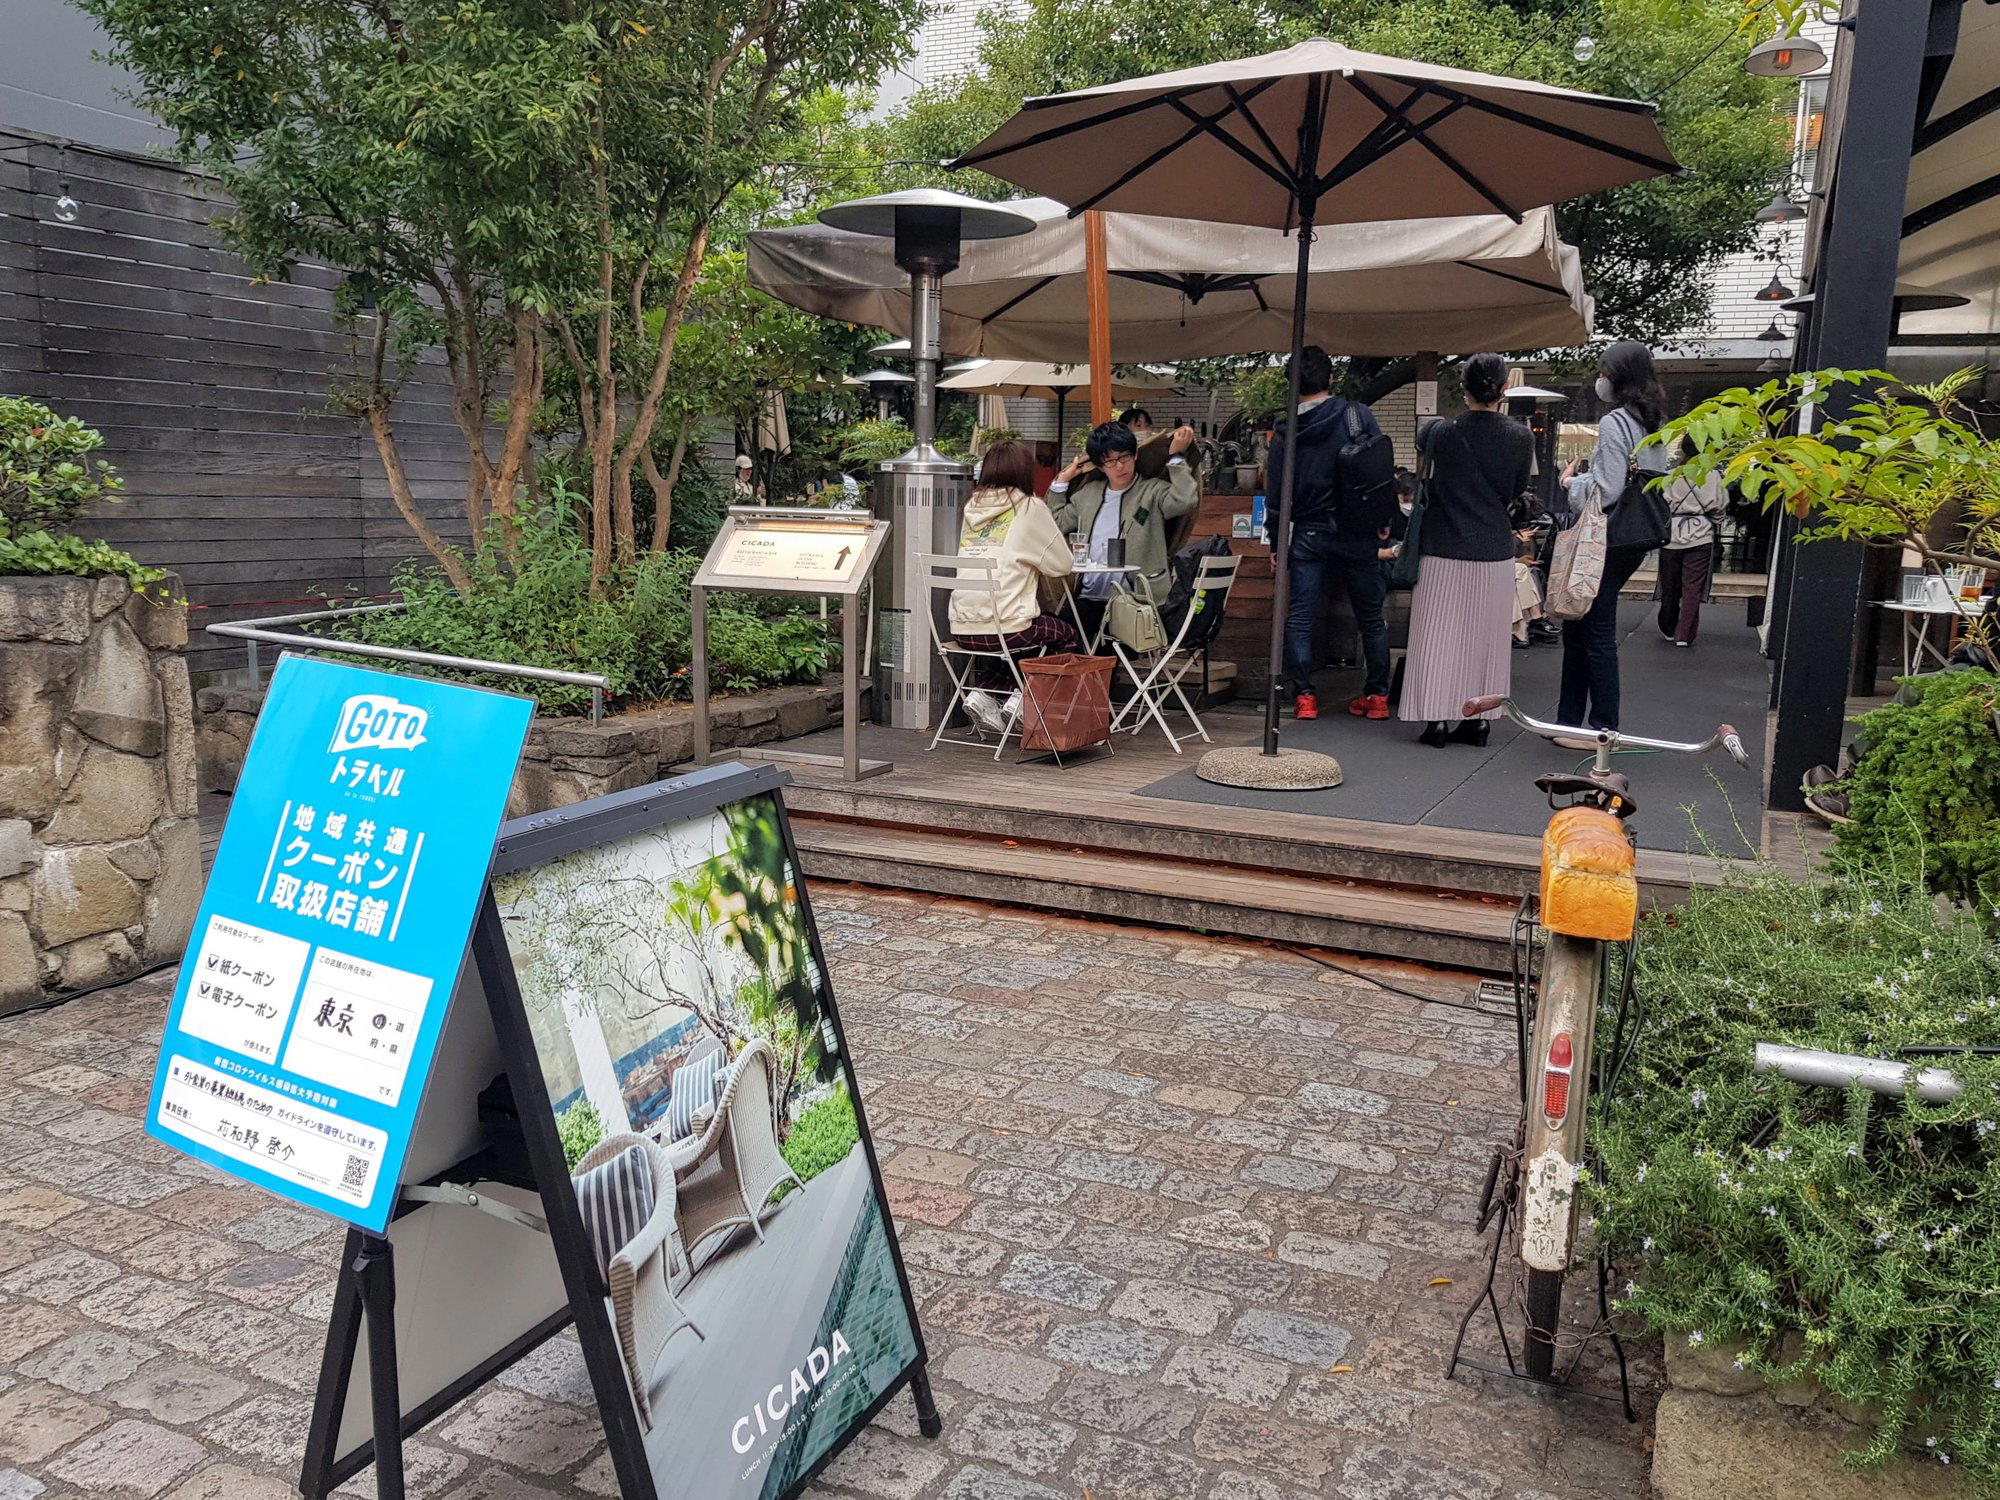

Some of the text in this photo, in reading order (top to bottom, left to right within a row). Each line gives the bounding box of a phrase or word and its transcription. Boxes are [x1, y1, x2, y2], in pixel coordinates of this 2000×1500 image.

[329, 756, 405, 796] トラベル
[293, 804, 408, 855] 地域共通
[284, 836, 399, 889] クーポン
[270, 872, 389, 937] 取扱店舗
[219, 959, 275, 987] 紙クーポン
[212, 986, 278, 1019] 電子クーポン
[313, 997, 355, 1036] 東京
[731, 1328, 851, 1455] CICADA
[741, 1458, 761, 1480] LUNCH
[810, 1397, 825, 1412] CAFE
